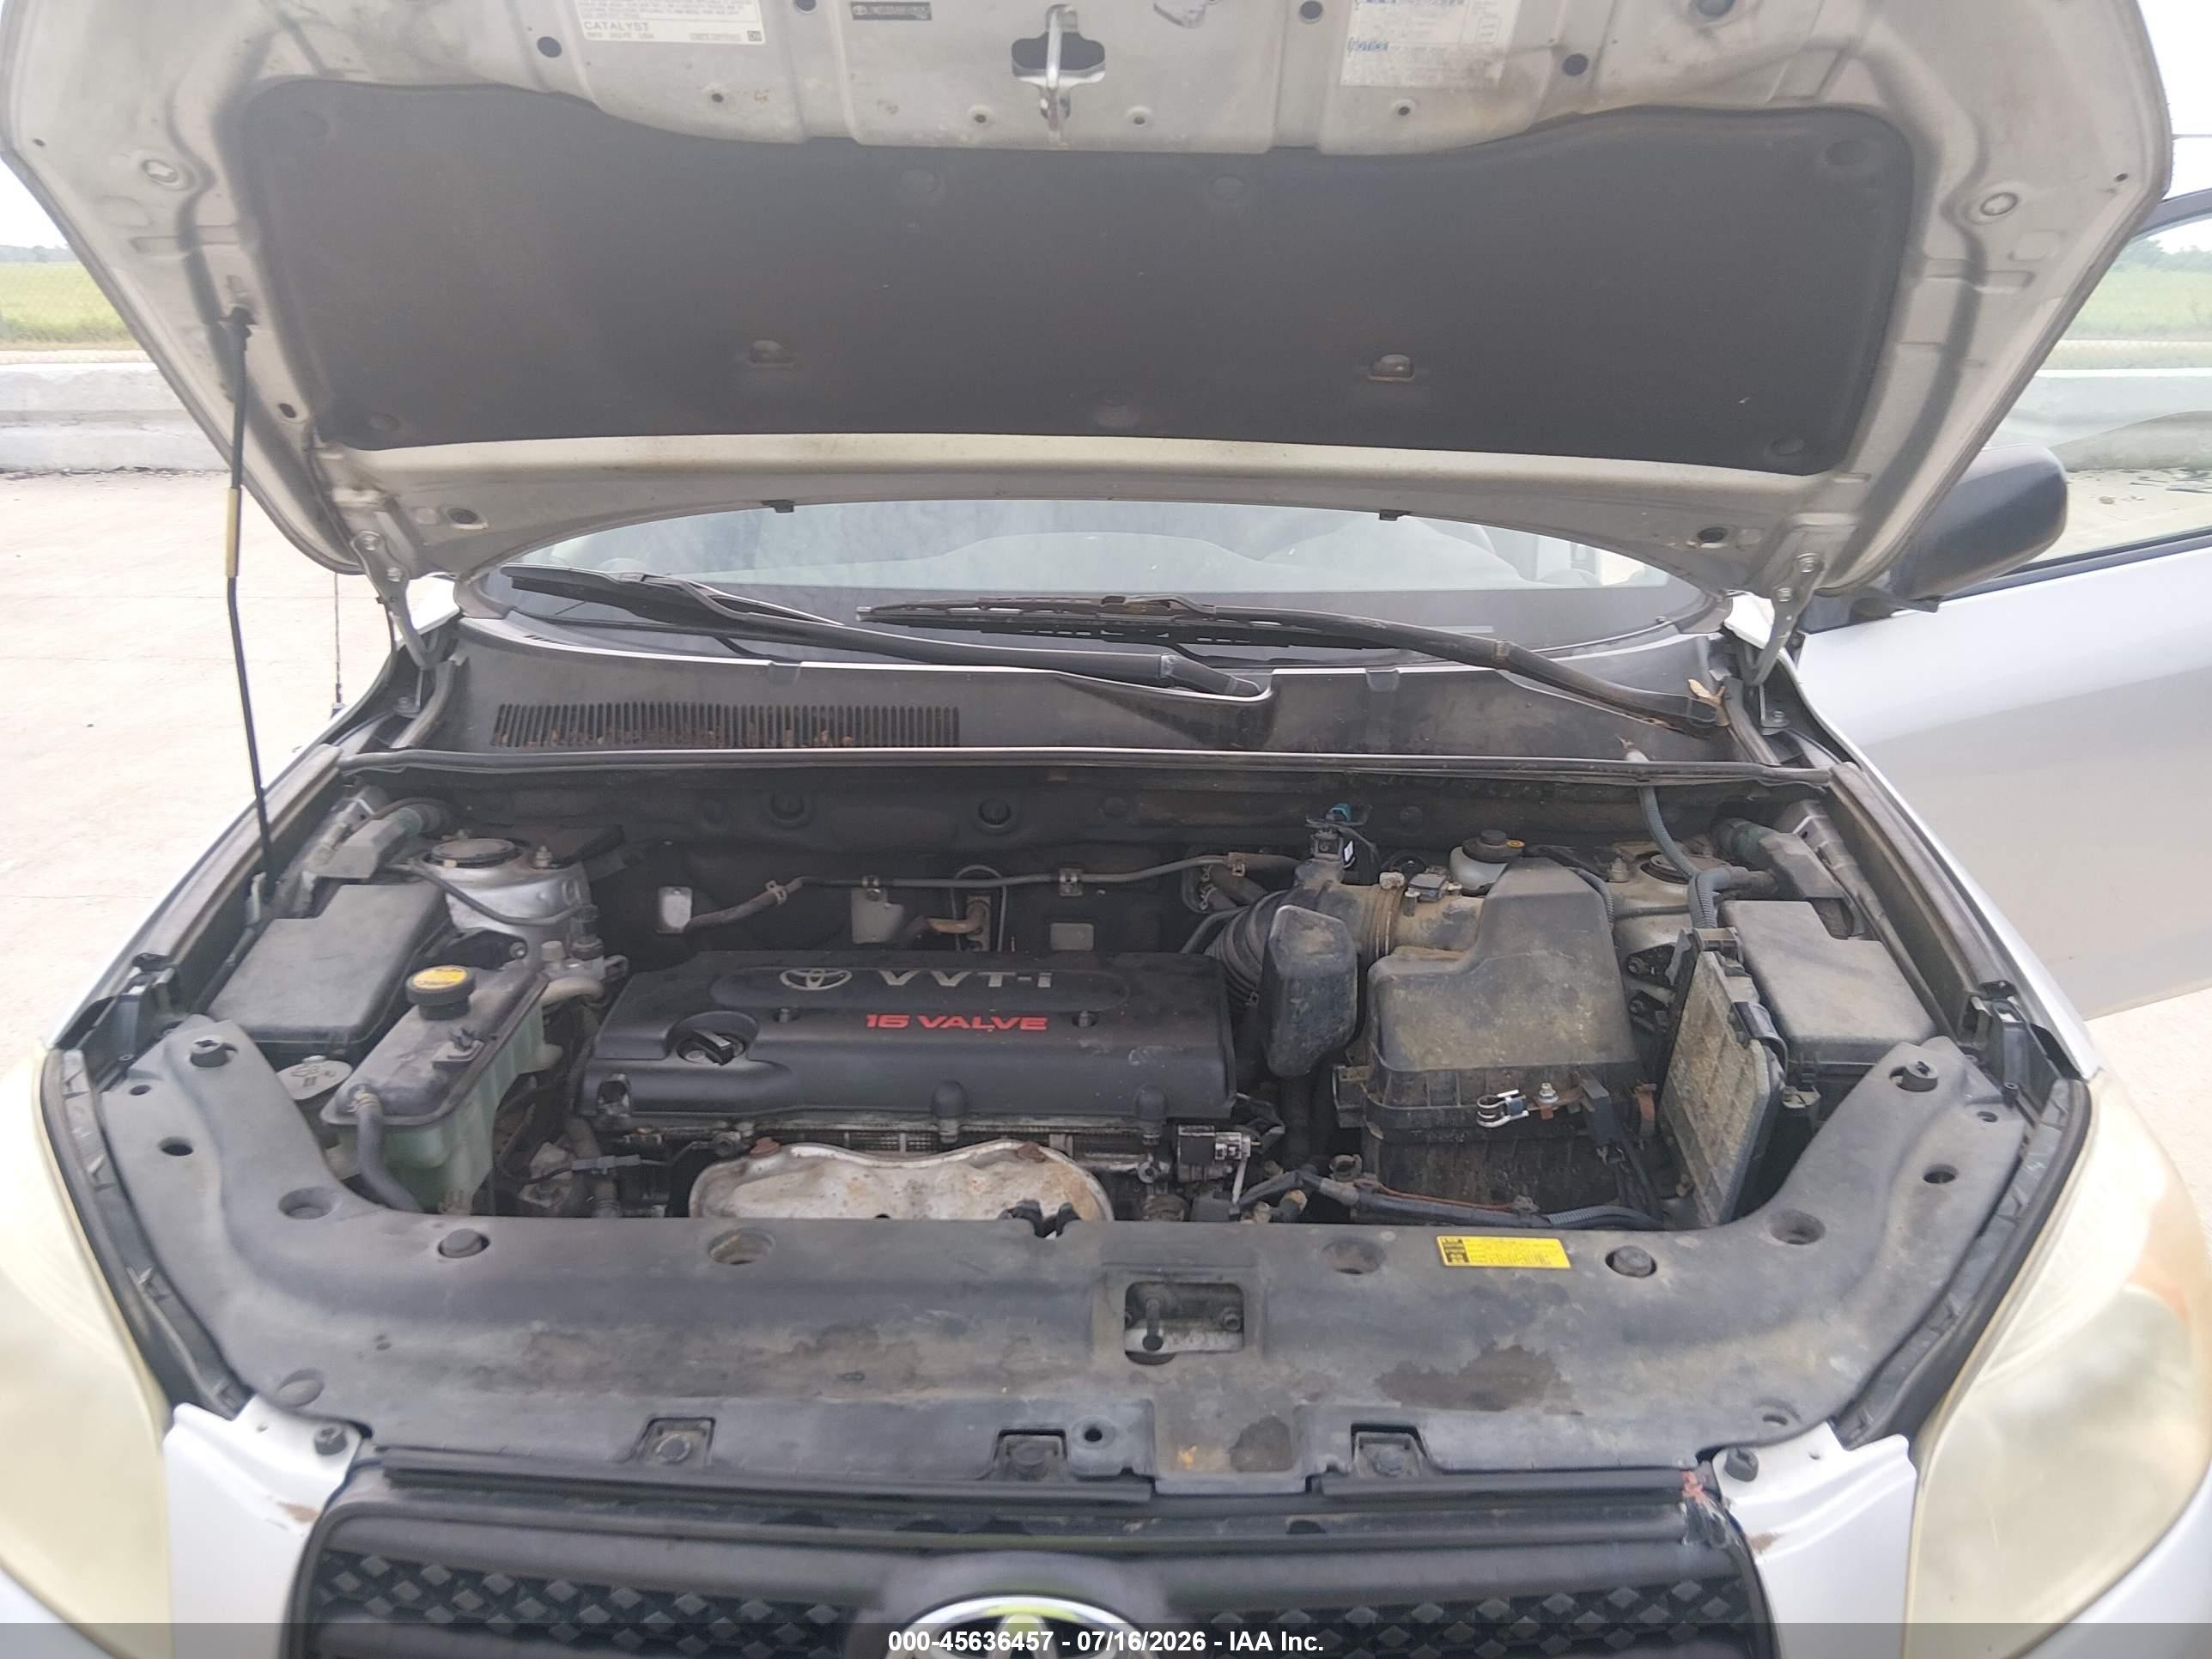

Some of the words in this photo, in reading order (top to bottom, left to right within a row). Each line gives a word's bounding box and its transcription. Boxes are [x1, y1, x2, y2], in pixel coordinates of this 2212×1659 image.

[584, 21, 649, 32] CATALYST
[878, 969, 1053, 988] VVT-i
[866, 1013, 910, 1029] 16
[917, 1015, 1048, 1030] VALVE
